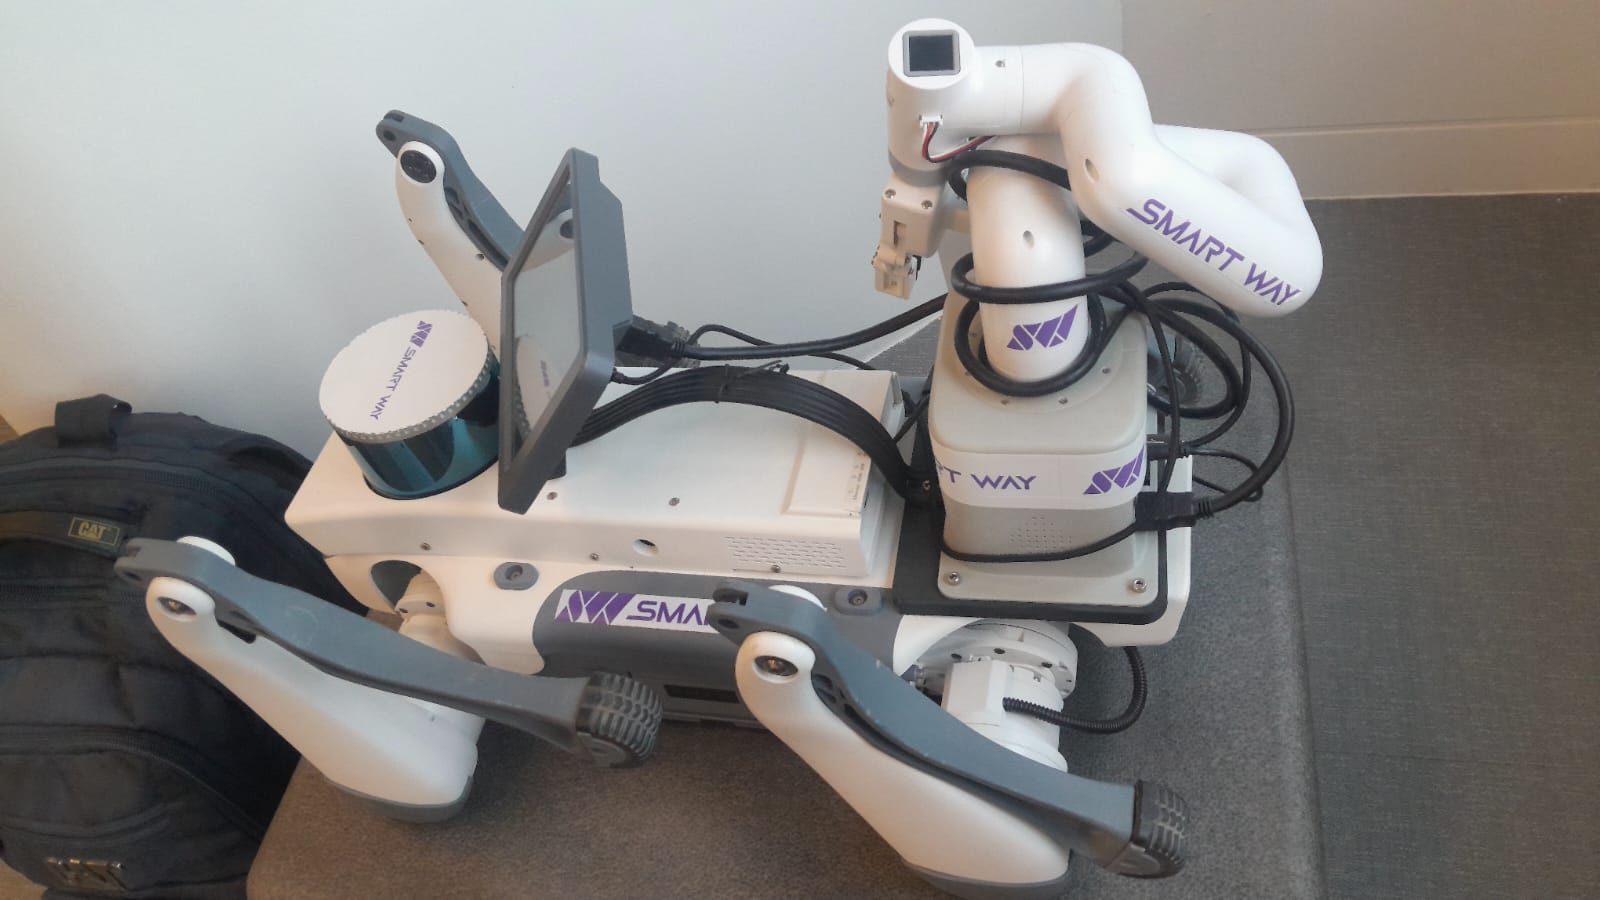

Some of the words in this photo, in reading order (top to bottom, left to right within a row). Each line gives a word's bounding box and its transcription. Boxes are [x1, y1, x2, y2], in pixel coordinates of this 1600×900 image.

[1126, 198, 1245, 271] SMART
[1244, 262, 1301, 305] WAY
[385, 346, 417, 391] SMART
[369, 395, 392, 420] WAY
[970, 474, 1036, 490] WAY
[78, 521, 107, 540] CAT
[625, 600, 709, 626] SMA
